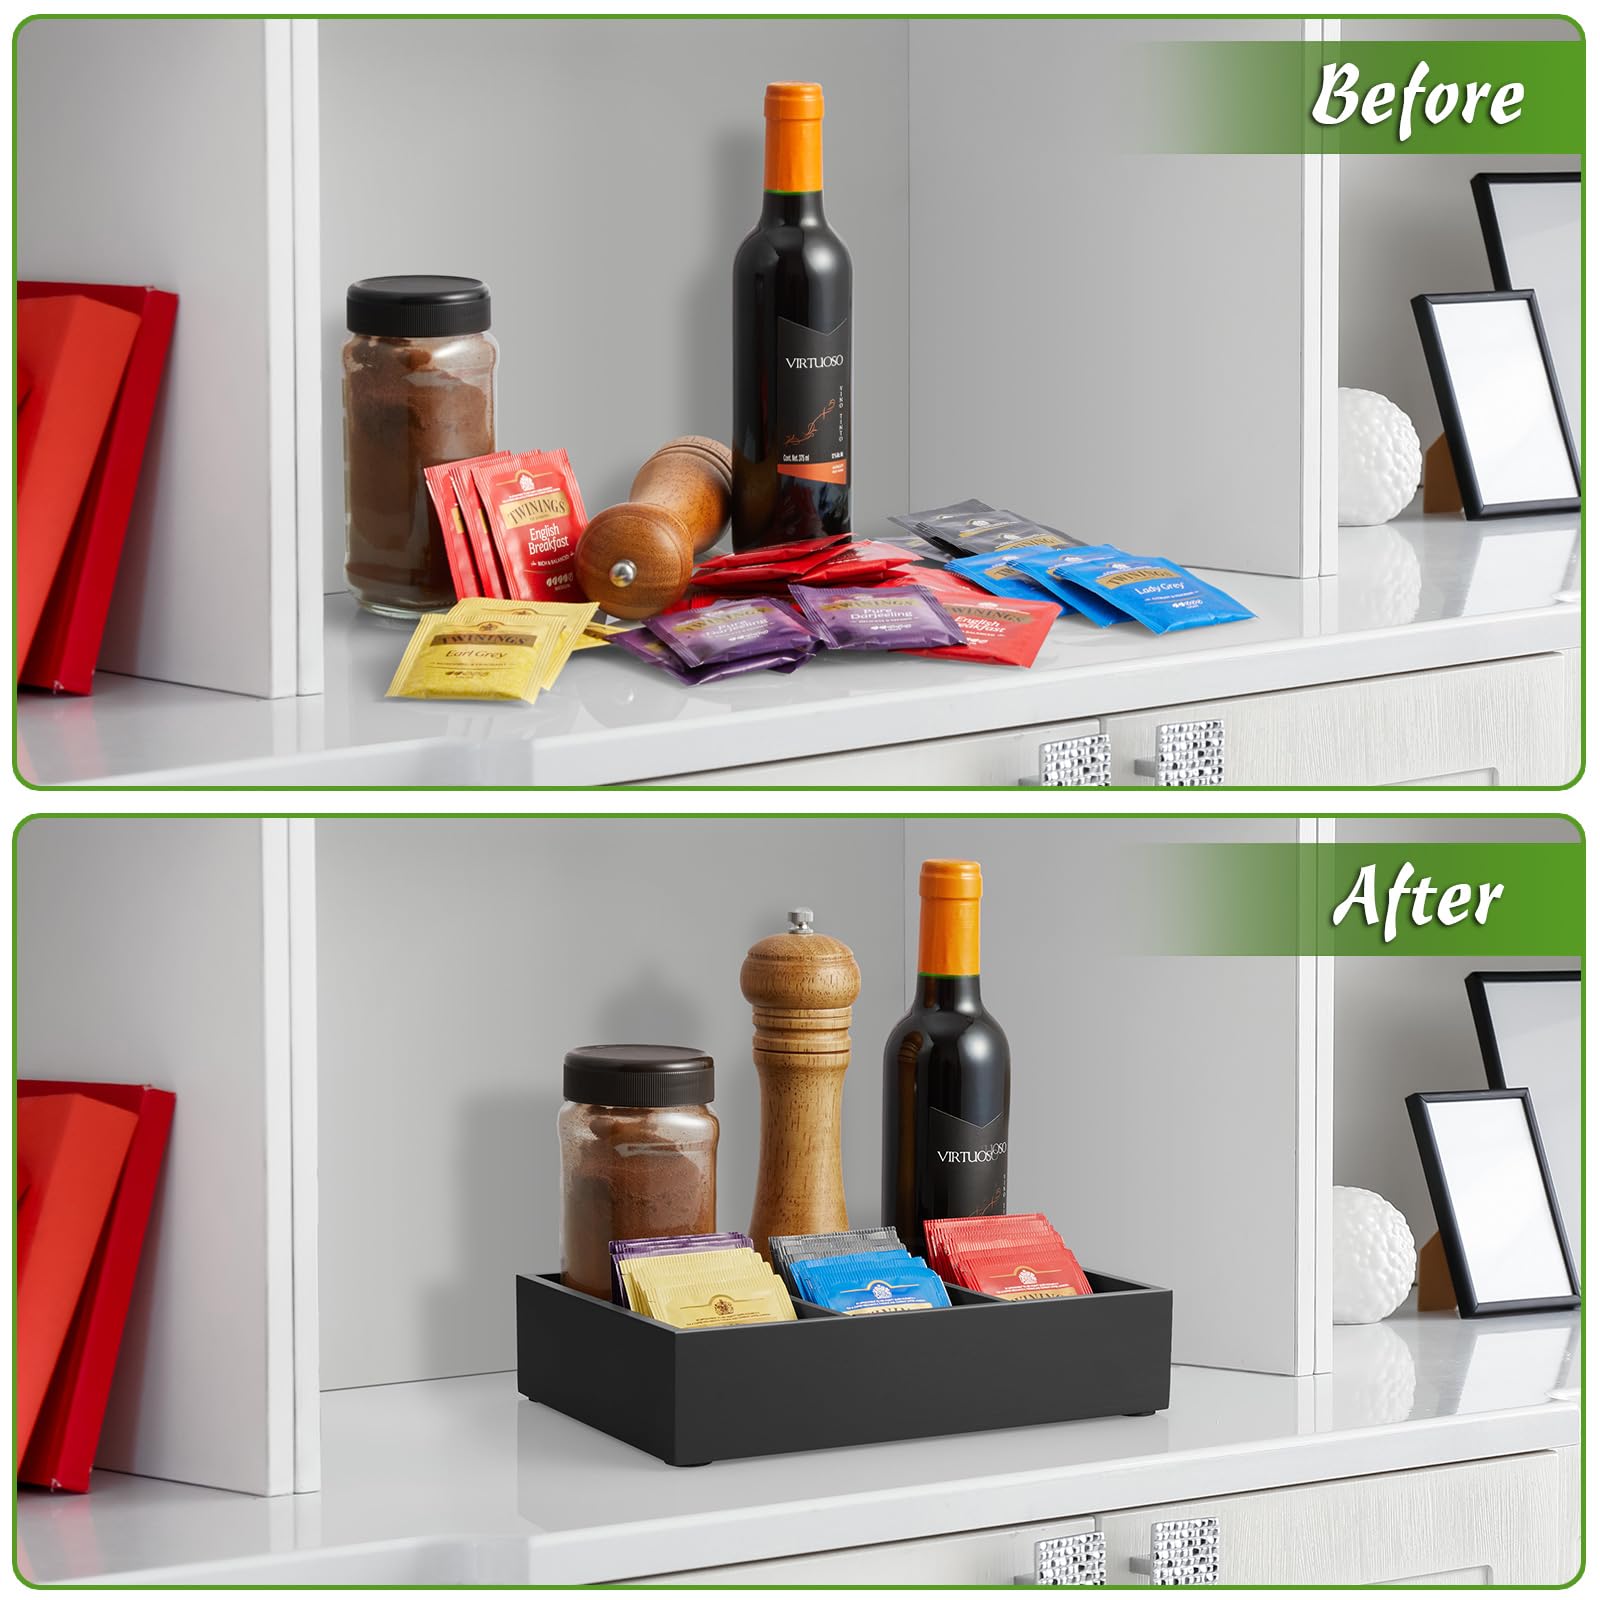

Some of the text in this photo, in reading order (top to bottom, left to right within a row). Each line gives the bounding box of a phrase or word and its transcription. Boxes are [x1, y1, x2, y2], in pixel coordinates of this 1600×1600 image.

[786, 354, 844, 369] VIRTUOSO
[508, 499, 567, 525] TWININGS
[529, 523, 560, 541] English
[528, 536, 570, 555] Breakfast
[1107, 570, 1173, 585] TWININGS
[1134, 585, 1160, 595] Lady
[1160, 582, 1184, 591] Grey
[850, 611, 913, 620] Darjeeling
[951, 607, 1023, 623] WININGS
[955, 616, 1000, 628] English
[442, 633, 525, 645] TWININGS
[446, 649, 508, 660] Earl Grey
